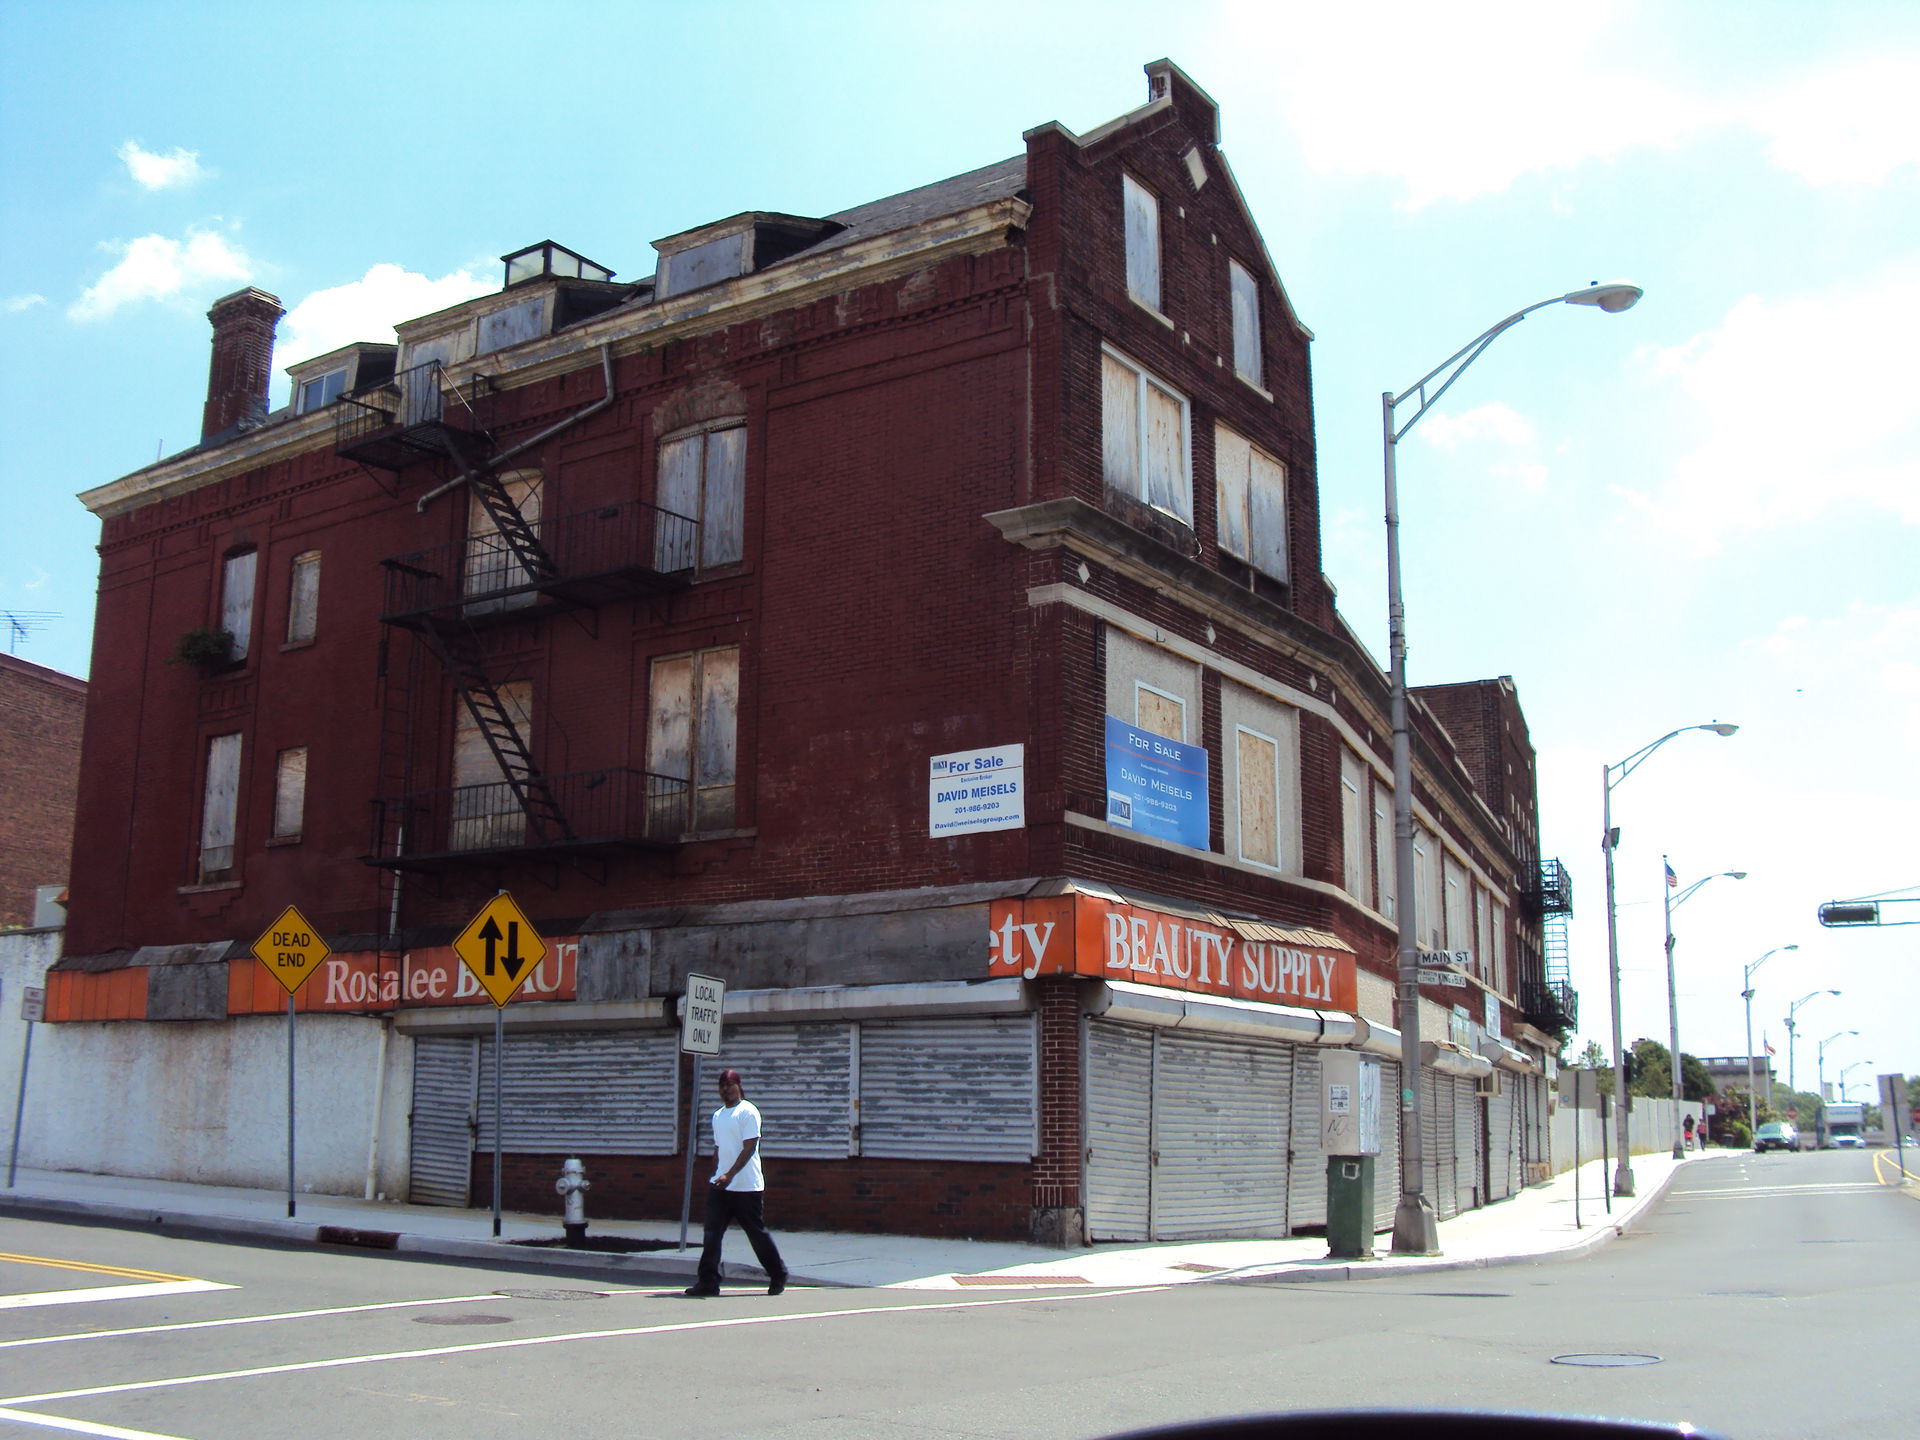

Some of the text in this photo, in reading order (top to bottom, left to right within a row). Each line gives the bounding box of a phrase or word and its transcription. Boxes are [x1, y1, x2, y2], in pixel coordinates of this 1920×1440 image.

[1128, 733, 1182, 761] FOR SALE
[949, 756, 1004, 773] For Sale
[937, 782, 1017, 803] DAVID MEISELS
[1121, 767, 1147, 786] DAVID
[1151, 779, 1193, 800] MEISELS
[954, 802, 1000, 814] 201-986-9203
[272, 932, 311, 948] DEAD
[277, 952, 306, 968] END
[1106, 912, 1337, 1002] BEAUTY SUPPLY
[1422, 951, 1469, 963] MAIN ST
[325, 953, 448, 1004] Rosalee
[694, 985, 716, 1003] LOCAL
[691, 1006, 718, 1024] TRAFFIC
[693, 1028, 712, 1044] ONLY
